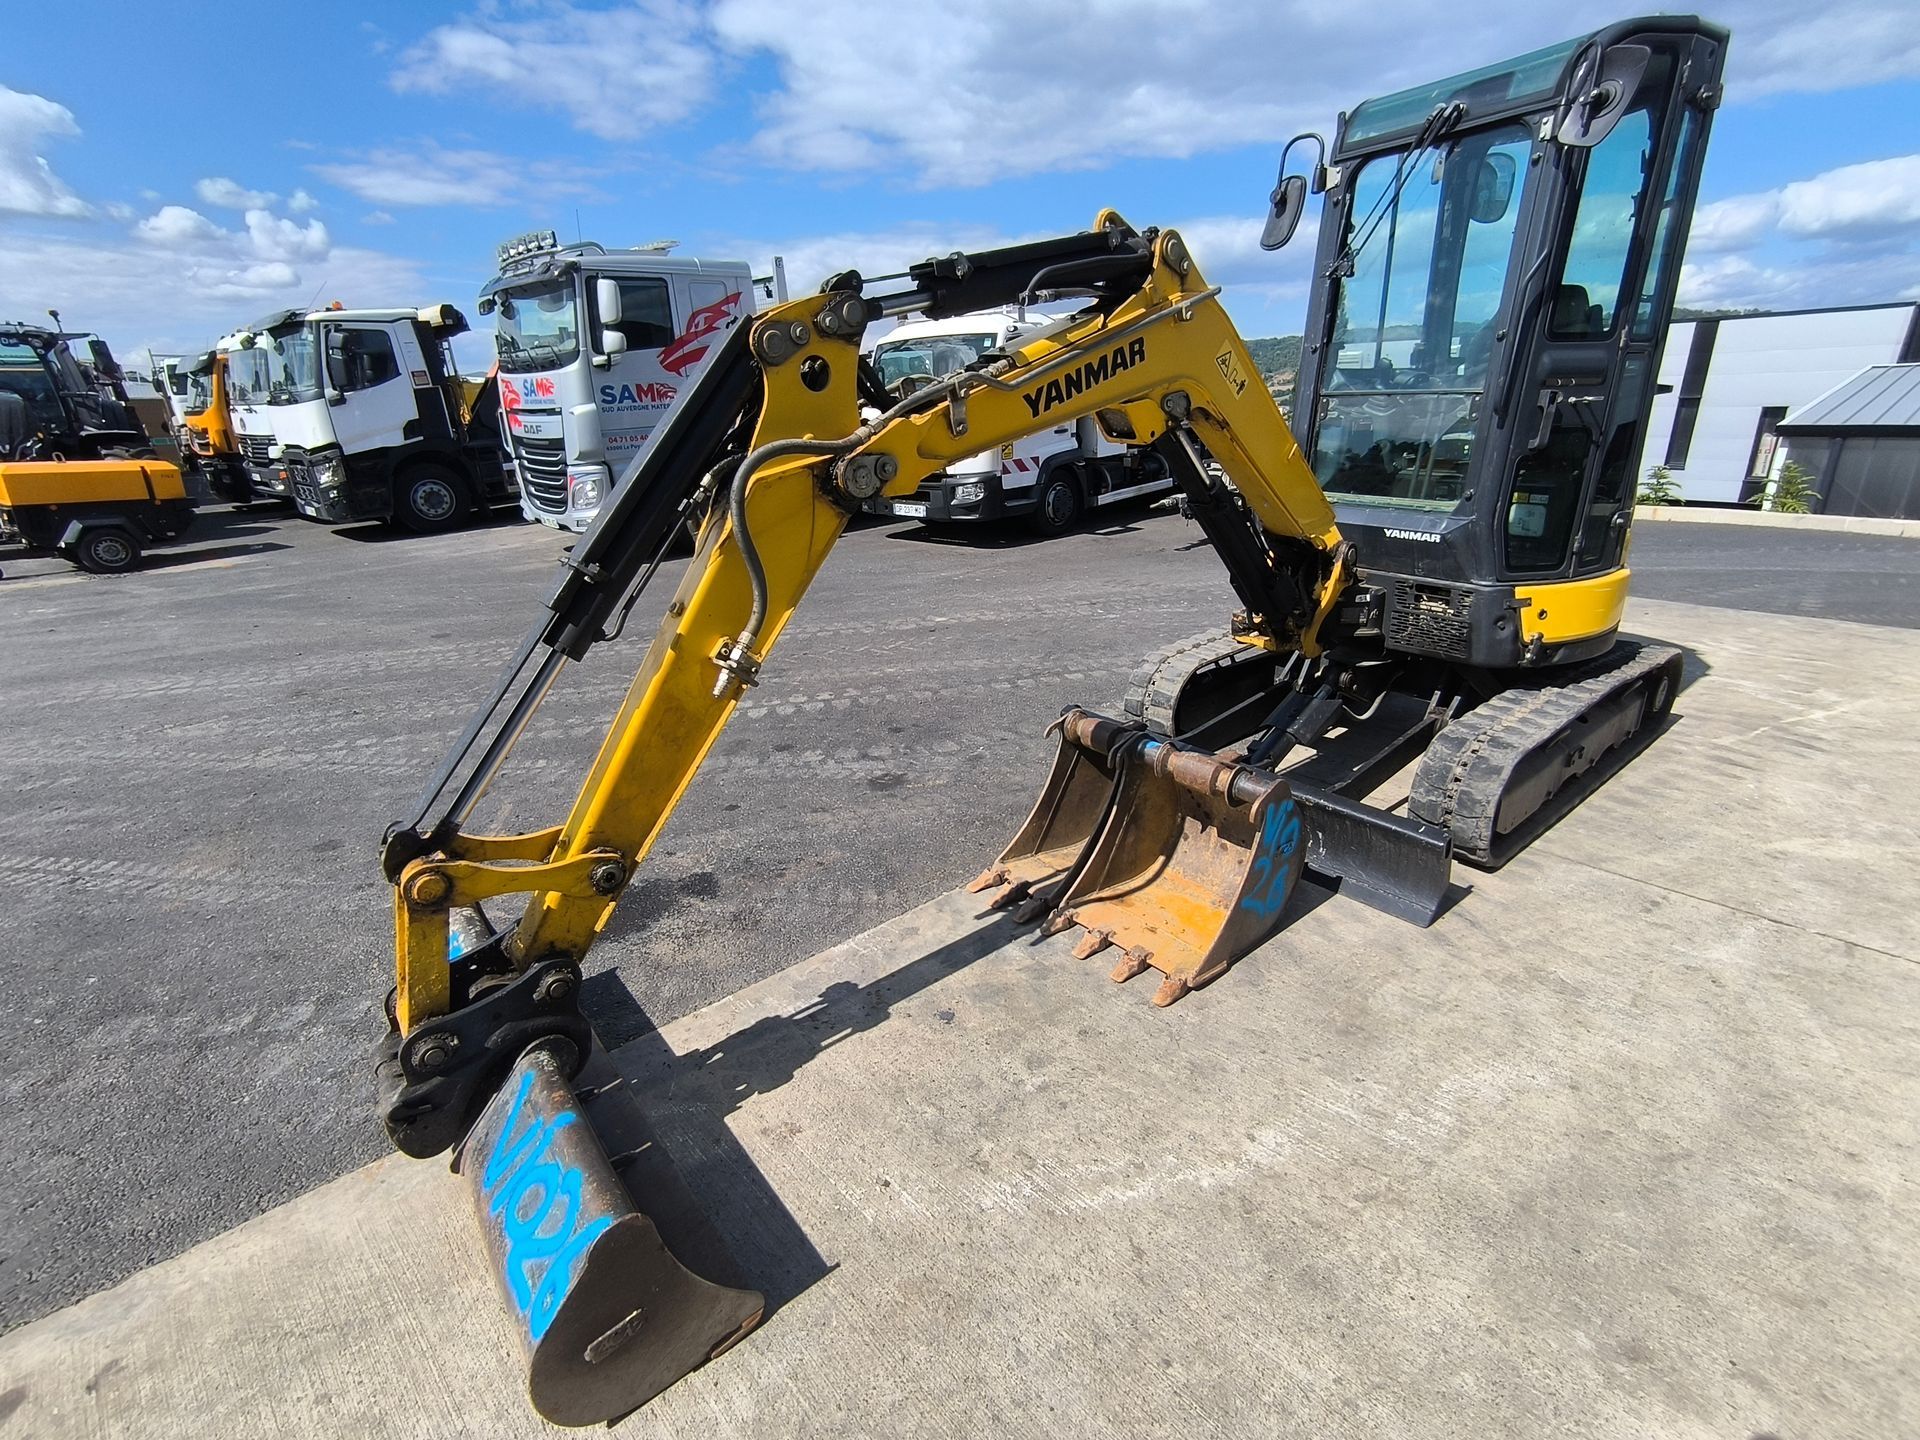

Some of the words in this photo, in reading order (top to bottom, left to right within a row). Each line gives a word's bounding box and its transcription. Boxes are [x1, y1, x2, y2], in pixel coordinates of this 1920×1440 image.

[1022, 336, 1146, 419] YANMAR
[600, 383, 657, 405] SAM
[616, 404, 650, 412] AUVERGNE
[523, 424, 543, 435] DAF
[608, 436, 618, 444] 04
[619, 435, 628, 443] 71
[1383, 528, 1441, 543] YANMAR
[1241, 856, 1290, 918] 26
